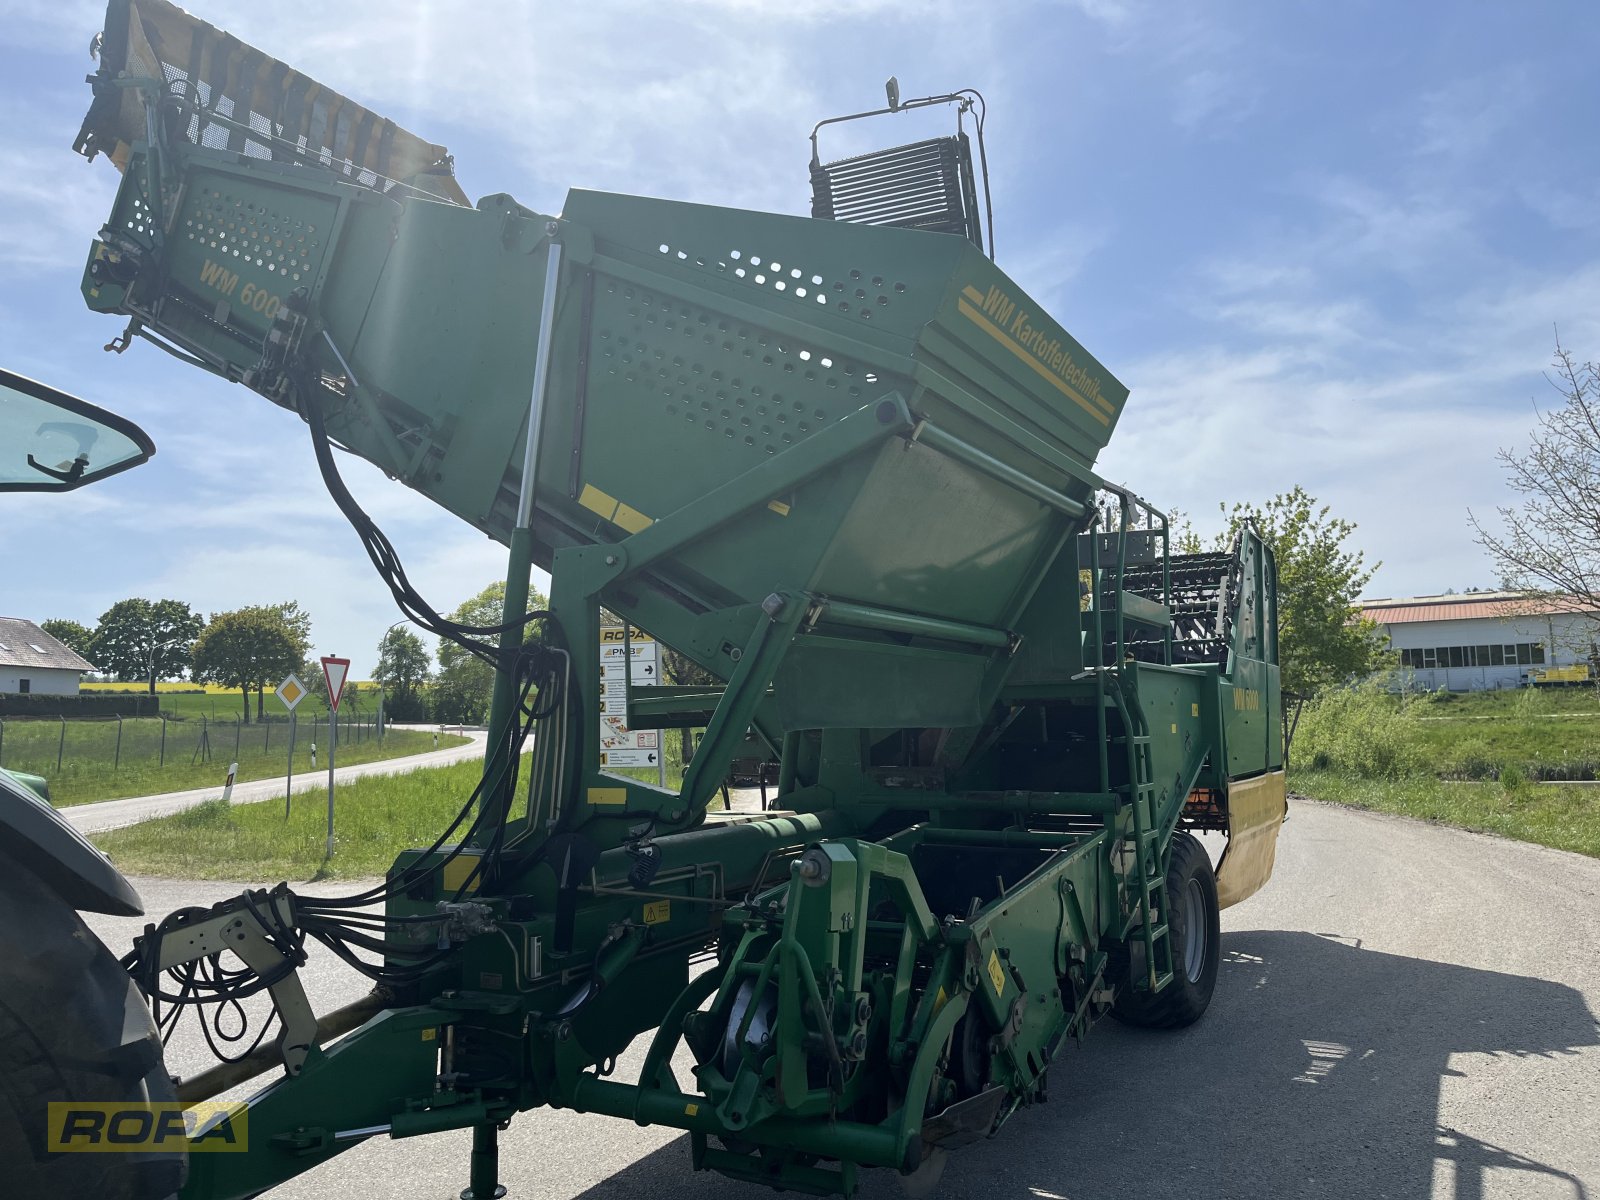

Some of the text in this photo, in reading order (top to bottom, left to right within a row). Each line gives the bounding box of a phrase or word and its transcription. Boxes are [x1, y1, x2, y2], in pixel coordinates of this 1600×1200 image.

[200, 259, 239, 296] WM
[982, 284, 1101, 401] WM Kartoffeltechnik
